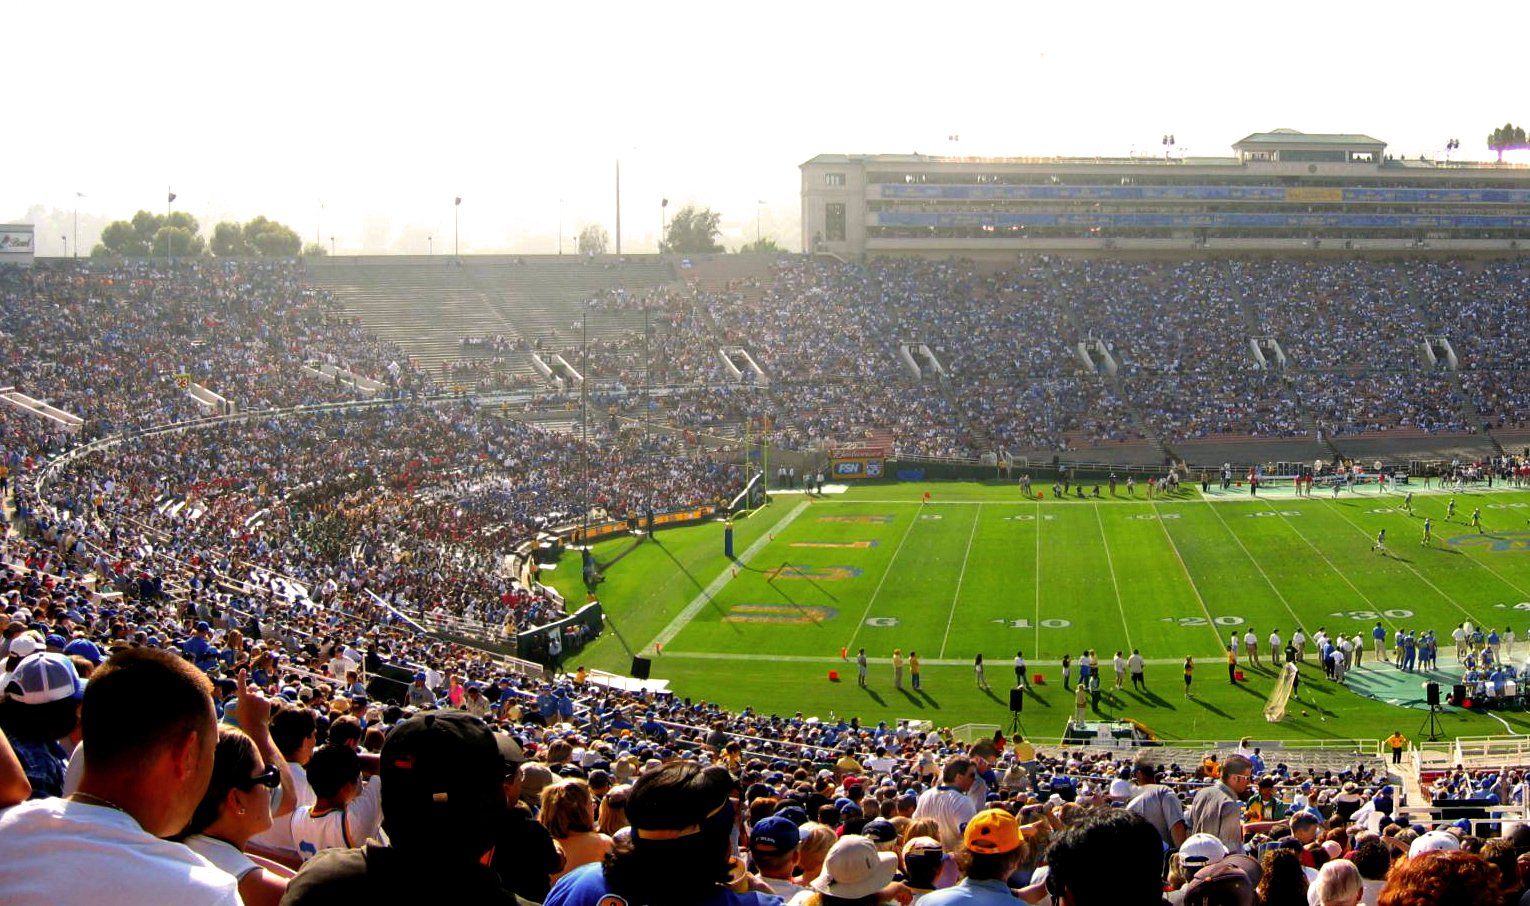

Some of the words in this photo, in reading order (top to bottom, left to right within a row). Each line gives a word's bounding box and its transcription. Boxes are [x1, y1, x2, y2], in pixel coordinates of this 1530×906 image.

[1348, 609, 1413, 620] 30
[1009, 618, 1071, 629] 10
[1178, 616, 1245, 626] 20
